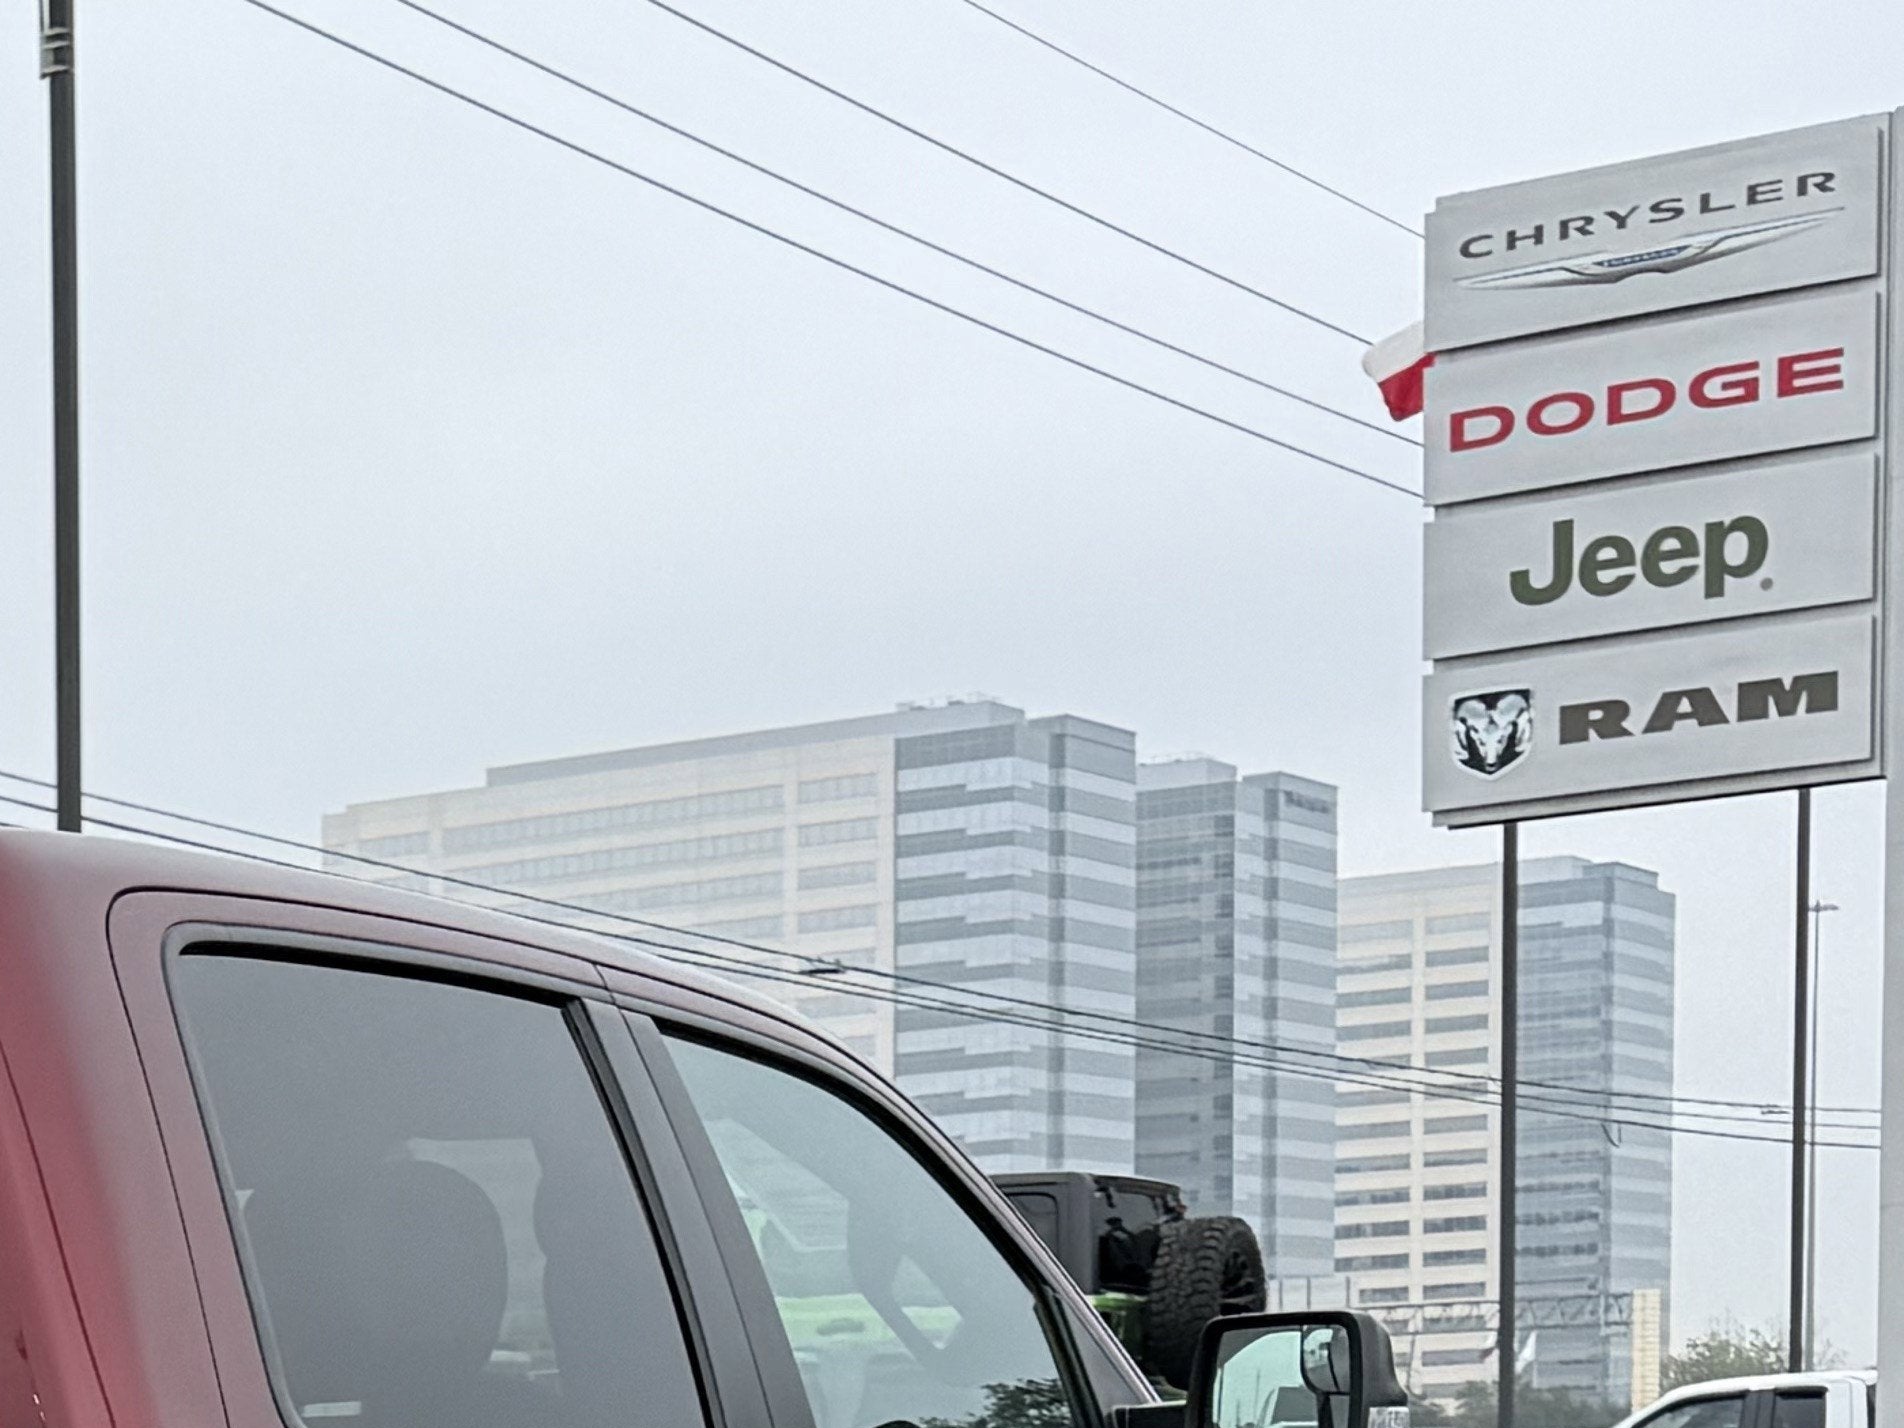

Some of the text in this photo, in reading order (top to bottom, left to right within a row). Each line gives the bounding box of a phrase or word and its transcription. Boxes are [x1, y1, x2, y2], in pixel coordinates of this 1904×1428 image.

[1458, 170, 1836, 259] CHRYSLER
[1449, 347, 1845, 453] DODGE
[1508, 515, 1770, 605] Jeep
[1558, 670, 1839, 746] RAM
